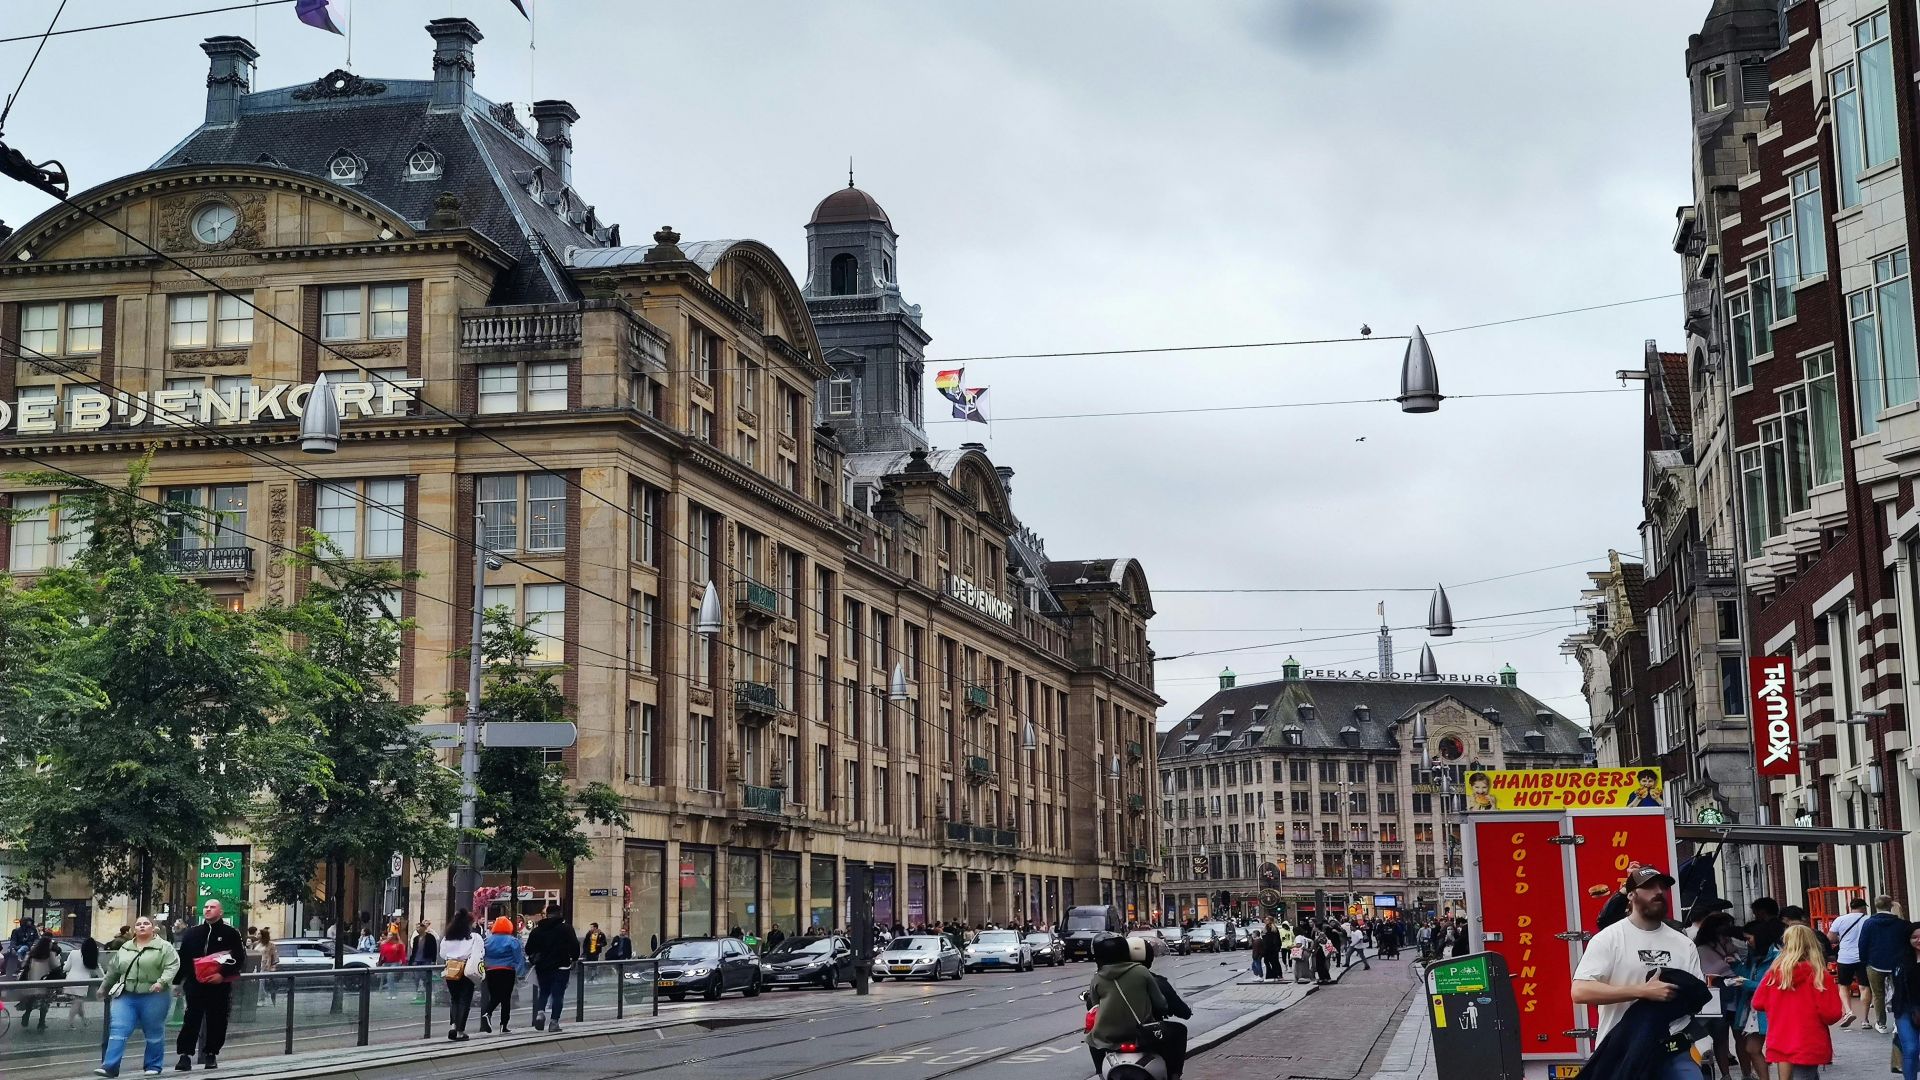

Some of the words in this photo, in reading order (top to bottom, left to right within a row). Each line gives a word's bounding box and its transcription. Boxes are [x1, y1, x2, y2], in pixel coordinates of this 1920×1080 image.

[953, 574, 967, 603] DE
[967, 582, 1014, 626] BIJENKORF
[1304, 669, 1347, 679] PEEK
[1352, 669, 1365, 679] &
[1367, 670, 1499, 684] CLOPPNBURG
[1492, 771, 1637, 790] HAMBURGERS
[1513, 789, 1618, 807] HOT-DOGS
[200, 857, 212, 870] P
[1511, 832, 1529, 894] COLD
[200, 871, 235, 879] Beursplein
[1517, 915, 1538, 1012] DRINKS
[1449, 967, 1458, 977] P
[852, 1055, 1053, 1066] BUS
